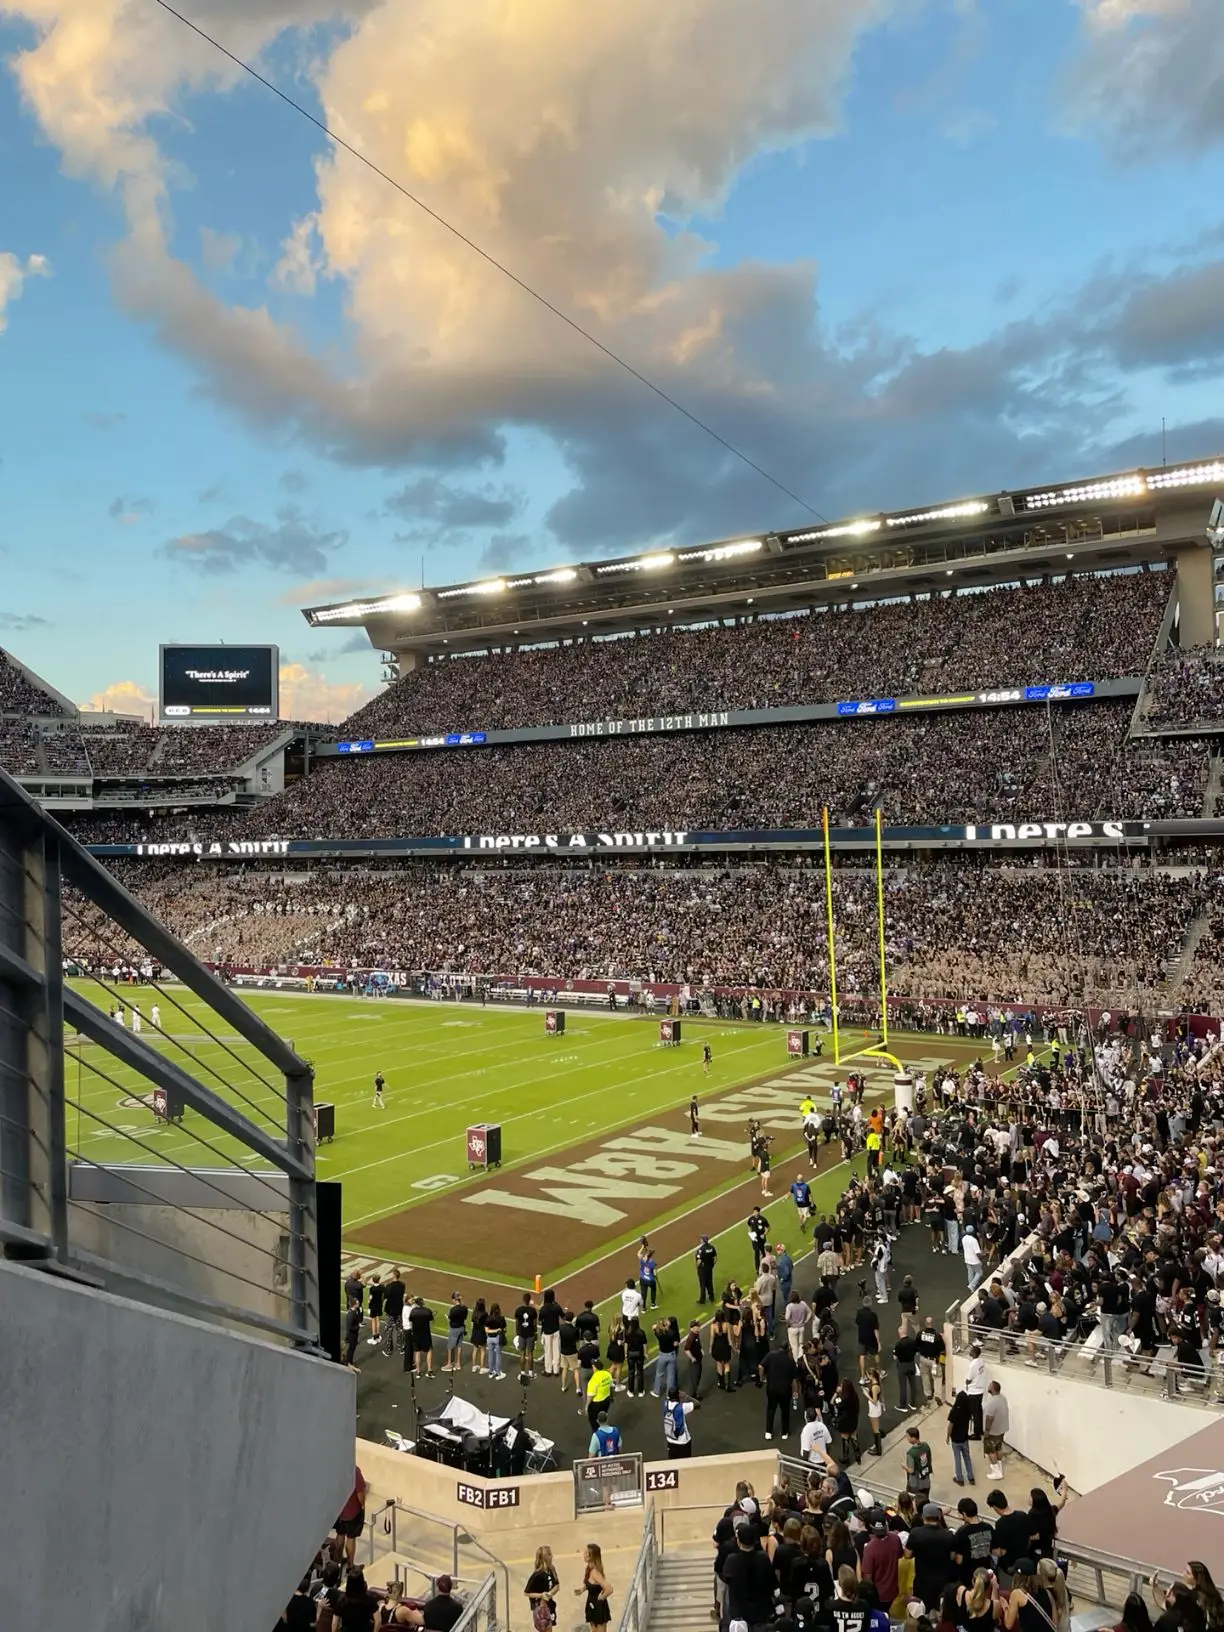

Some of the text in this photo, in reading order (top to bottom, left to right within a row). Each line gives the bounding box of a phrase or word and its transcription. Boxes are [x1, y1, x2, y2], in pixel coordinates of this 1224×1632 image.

[978, 690, 1020, 702] 14:54
[1047, 686, 1071, 698] Ford
[857, 703, 877, 713] Ford
[570, 712, 729, 737] HOME OF THE 12TH MAN
[461, 1126, 752, 1227] A&M
[648, 1472, 676, 1489] 134
[458, 1485, 483, 1506] FB2
[489, 1489, 516, 1507] FB1
